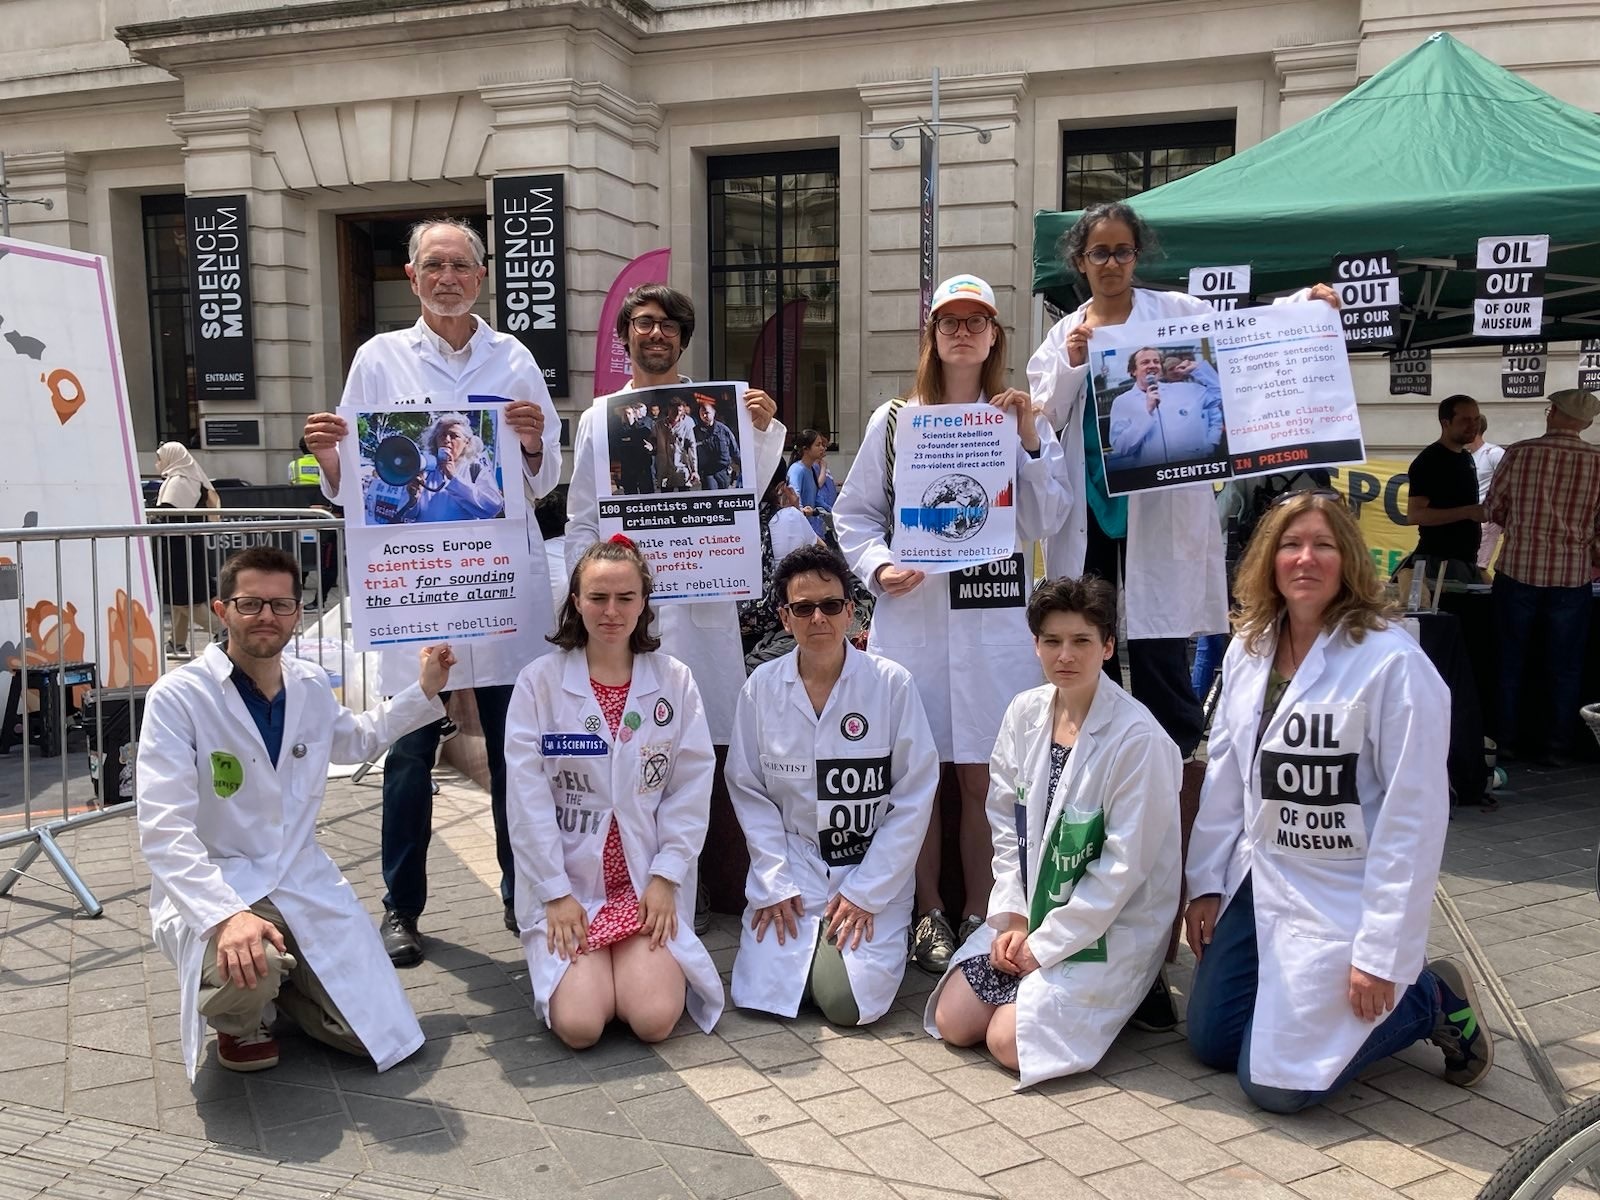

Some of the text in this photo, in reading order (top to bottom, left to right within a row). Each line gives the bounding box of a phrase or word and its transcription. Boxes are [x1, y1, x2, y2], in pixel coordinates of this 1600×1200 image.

[530, 188, 556, 330] MUSEUM
[1492, 242, 1532, 264] OIL
[217, 207, 243, 337] MUSEUM
[504, 197, 530, 331] SCIENCE
[1338, 257, 1392, 278] COAL
[195, 216, 221, 339] SCIENCE
[1202, 272, 1236, 291] OIL
[1486, 272, 1533, 294] OUT
[1342, 282, 1390, 306] OUT
[1485, 302, 1530, 314] OF OUR
[1344, 310, 1389, 324] OF OUR
[1482, 318, 1532, 330] MUSEUM
[1158, 317, 1257, 337] #FreeMike
[1344, 326, 1393, 340] MUSEUM
[1216, 331, 1272, 346] scientist
[1228, 345, 1334, 364] co-founder sentenced:
[610, 358, 624, 373] THE
[1230, 354, 1336, 374] 23 months in prison
[1276, 368, 1293, 376] for
[205, 373, 244, 382] ENTRANCE
[1236, 374, 1335, 394] non-violent direct
[1296, 405, 1335, 415] climate
[912, 412, 1004, 428] #FreeMike
[1230, 413, 1353, 436] criminals enjoy record
[958, 430, 992, 438] Rebellion
[1270, 428, 1315, 441] profits.
[917, 440, 1000, 450] co-founder sentenced
[924, 450, 954, 459] months
[965, 451, 990, 460] prison
[911, 461, 955, 470] non-violent
[1156, 449, 1309, 480] SCIENTIST IN PRISON
[602, 498, 754, 514] 100 scientists are facing
[626, 516, 676, 527] criminal
[384, 540, 492, 555] Across Europe
[670, 536, 694, 547] real
[700, 535, 740, 545] climate
[673, 549, 703, 560] enjoy
[708, 546, 744, 556] record
[900, 548, 952, 556] scientist
[368, 555, 510, 573] scientists are on
[656, 562, 704, 573] profits.
[988, 560, 1018, 576] OUR
[364, 570, 514, 590] trial for sounding
[366, 586, 514, 607] the climate alarm!
[959, 582, 1020, 598] MUSEUM
[370, 622, 440, 636] scientist
[1283, 712, 1340, 748] OIL
[552, 770, 596, 794] TELL
[1277, 762, 1343, 796] OUT
[566, 793, 583, 806] THE
[1280, 806, 1346, 830] OF OUR
[1277, 829, 1354, 850] MUSEUM
